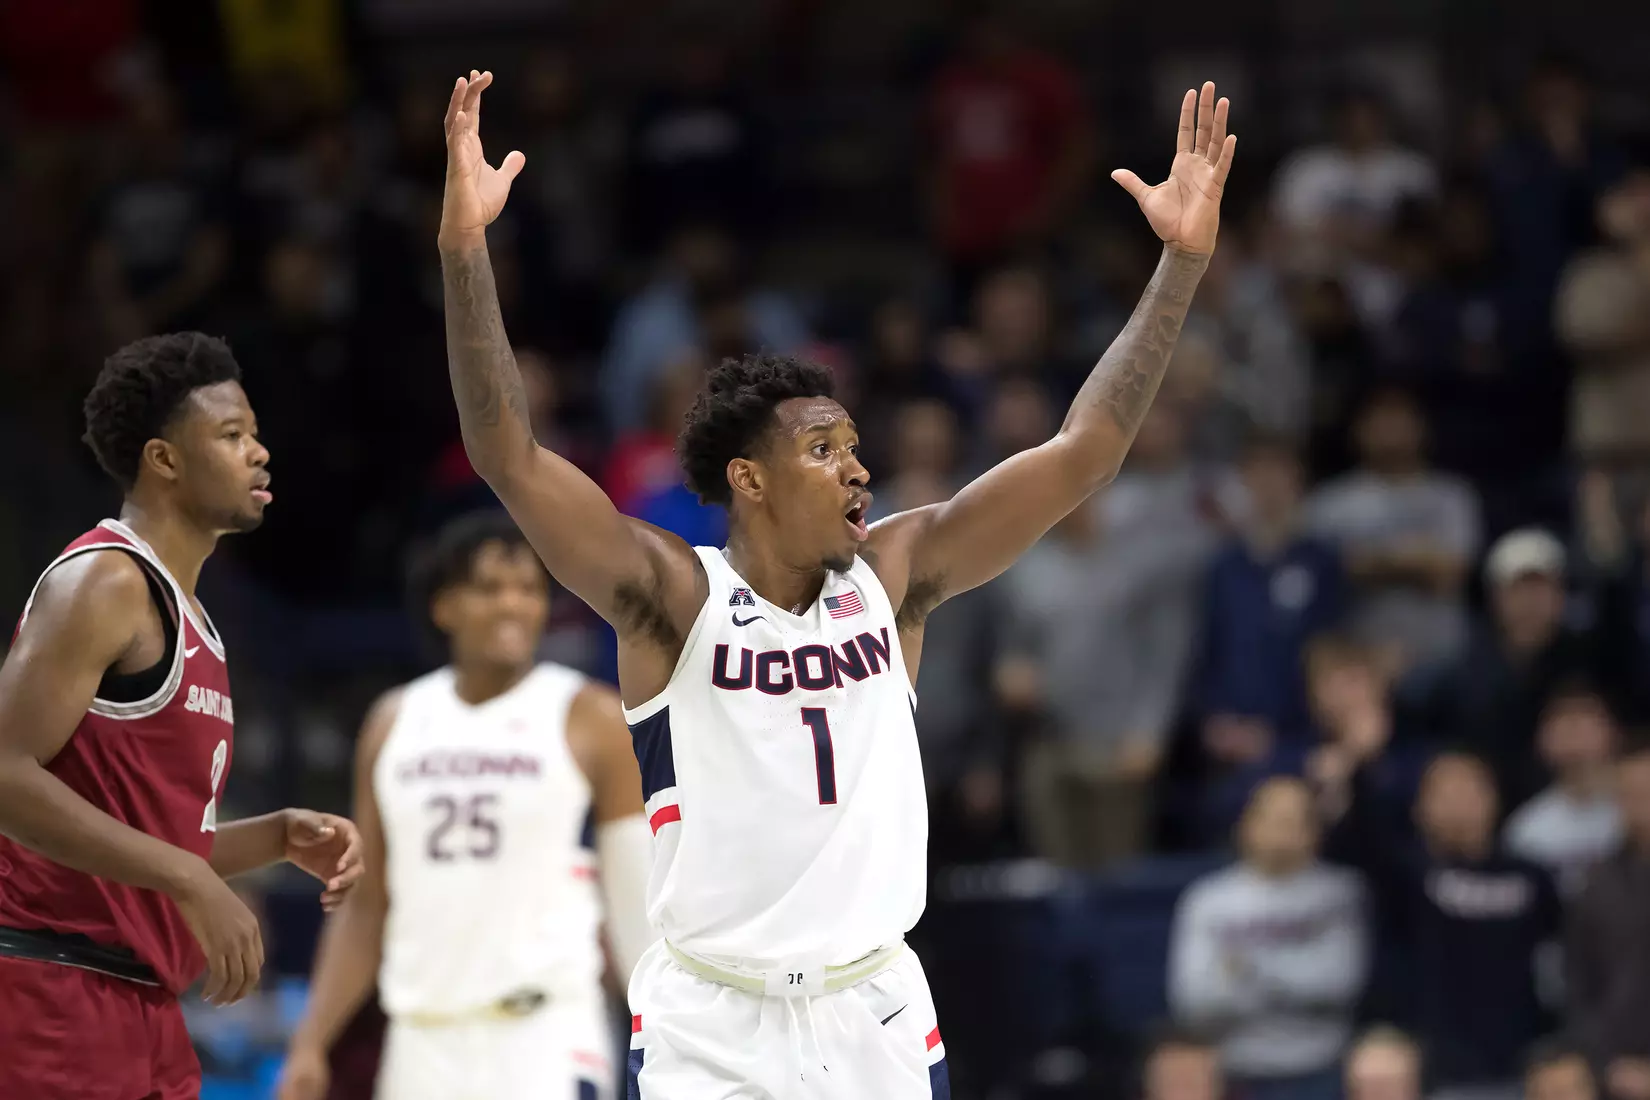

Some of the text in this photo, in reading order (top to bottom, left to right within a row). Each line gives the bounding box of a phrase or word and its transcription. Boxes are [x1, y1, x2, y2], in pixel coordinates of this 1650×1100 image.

[712, 627, 890, 695] UCONN
[183, 684, 221, 718] SAINT
[801, 707, 837, 805] 1
[423, 794, 502, 861] 25
